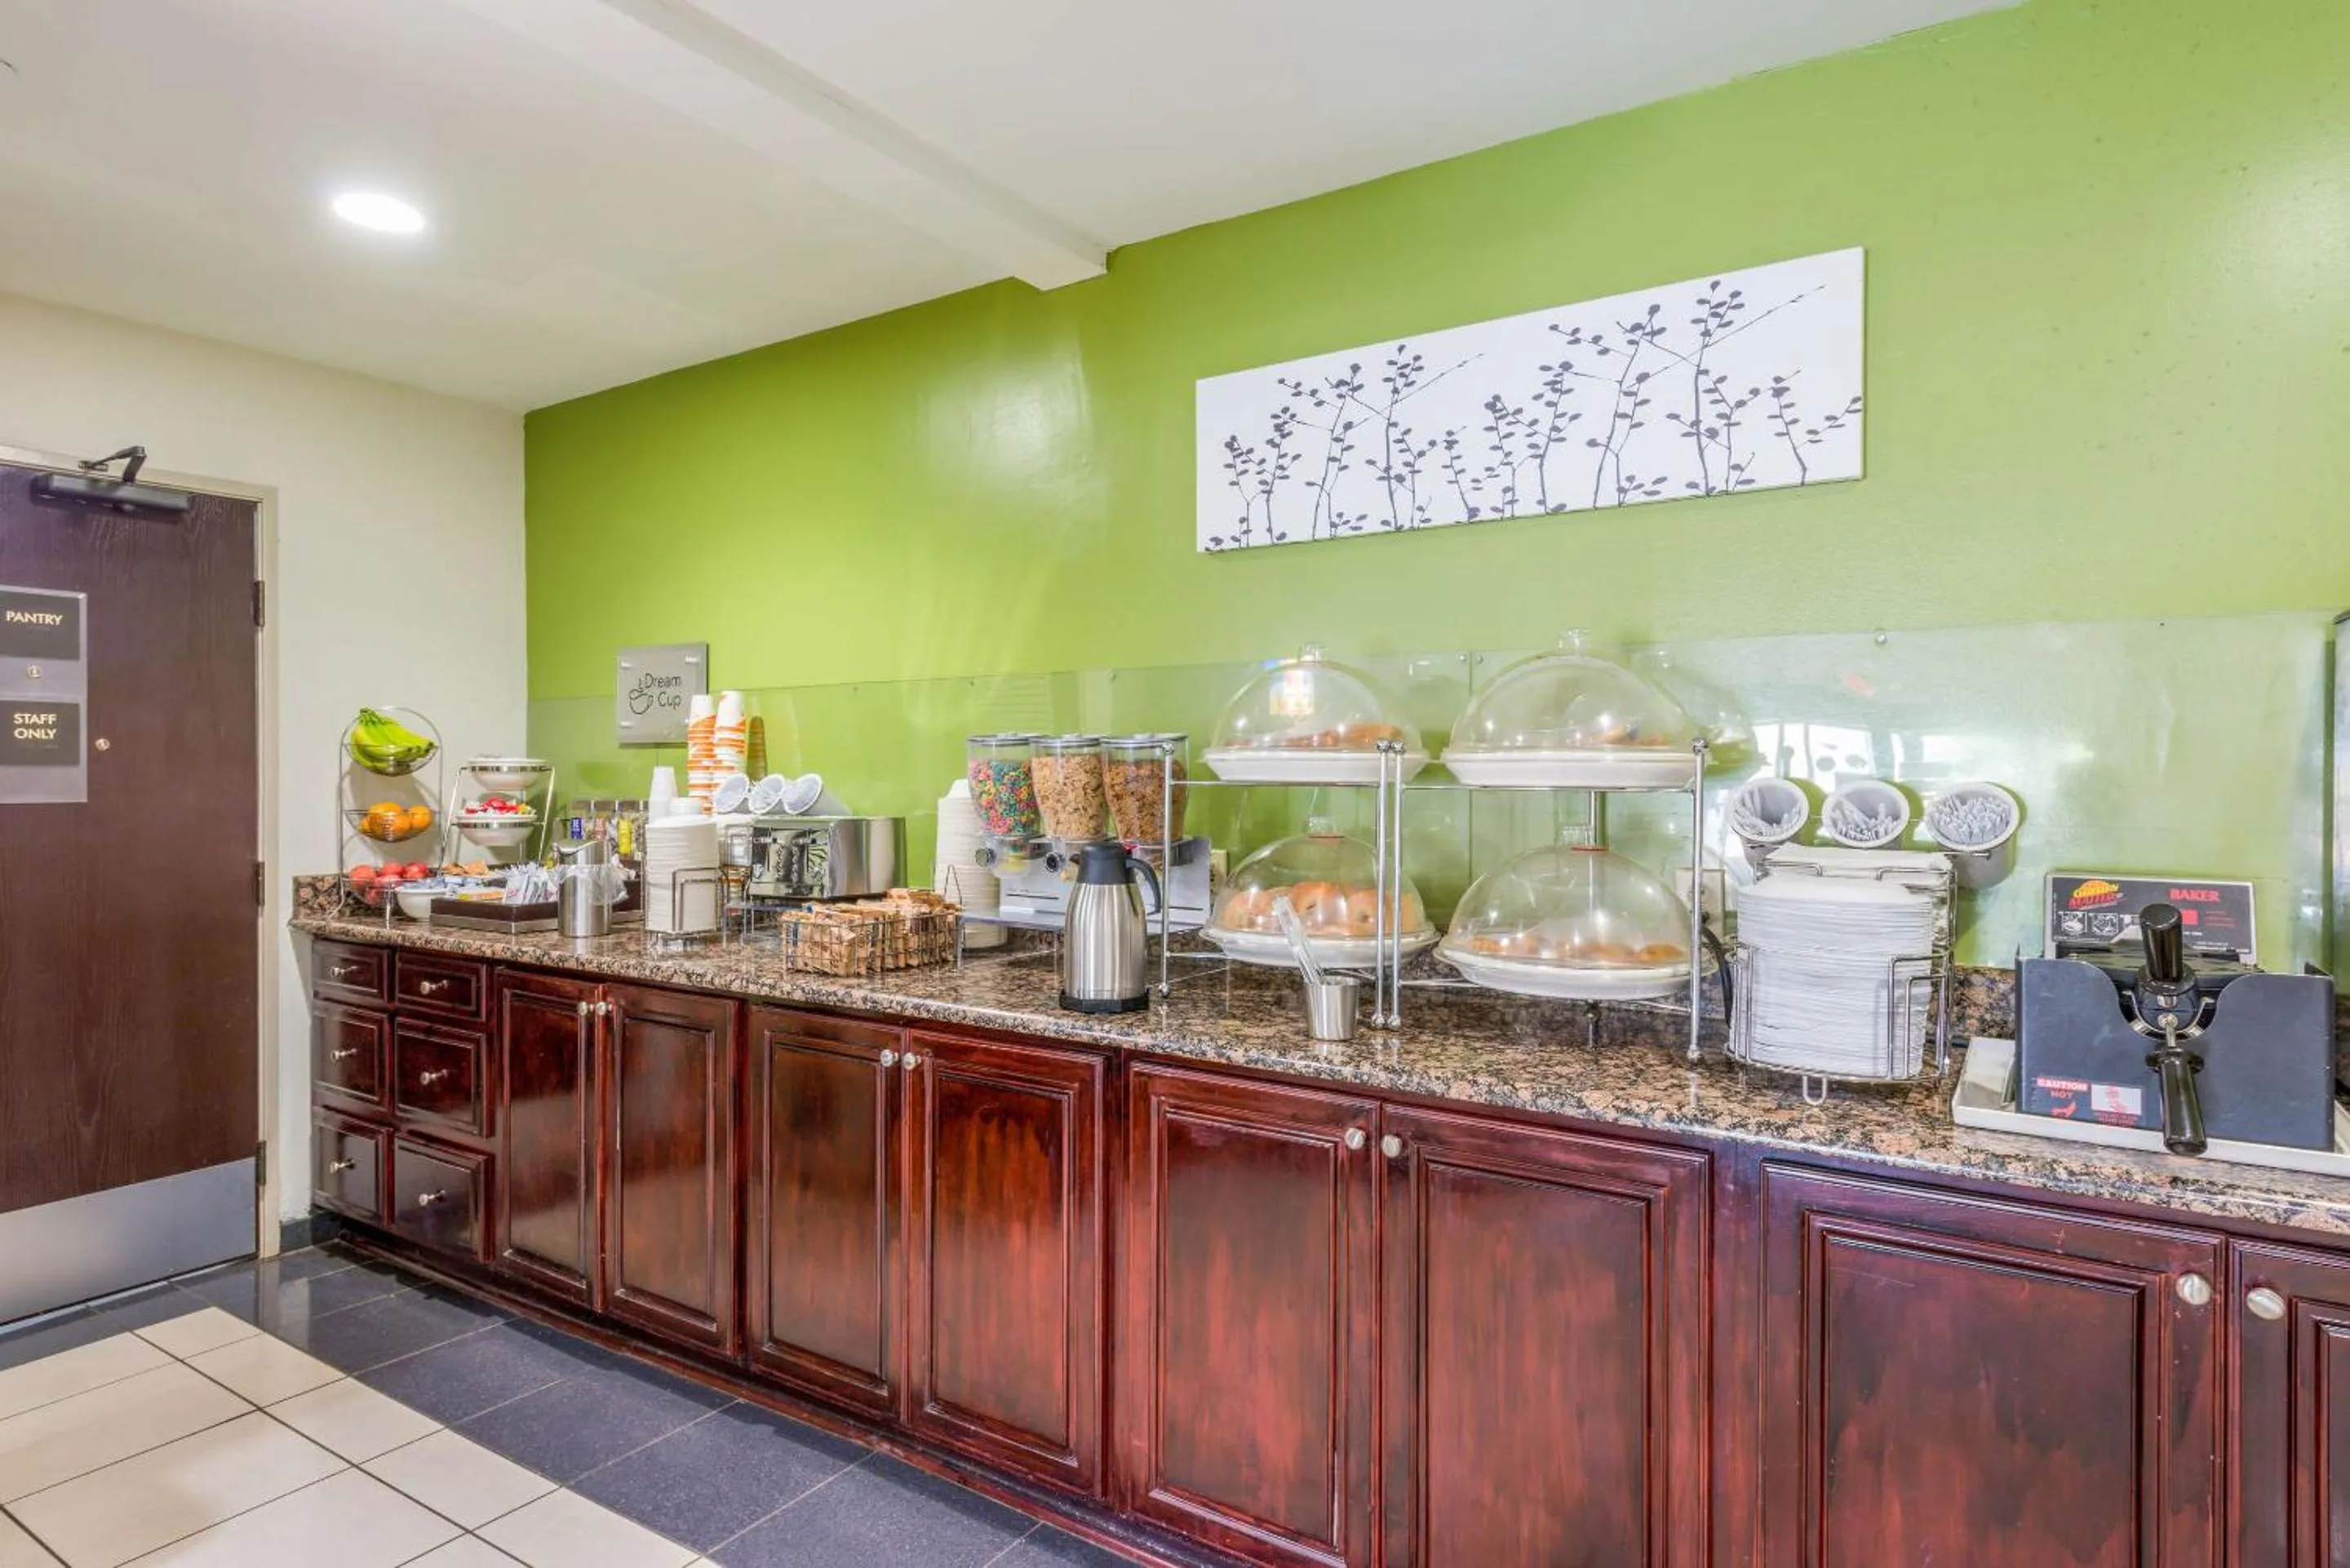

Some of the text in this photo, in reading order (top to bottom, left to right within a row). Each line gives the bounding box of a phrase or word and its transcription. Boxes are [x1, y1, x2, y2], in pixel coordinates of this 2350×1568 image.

[6, 610, 63, 626] PANTRY
[645, 672, 682, 689] Dream
[658, 691, 682, 710] Cup
[13, 713, 57, 724] STAFF
[14, 728, 57, 739] ONLY
[2170, 888, 2219, 902] BAKER
[2037, 1078, 2088, 1091] CAUTION
[2051, 1090, 2074, 1099] HOT
